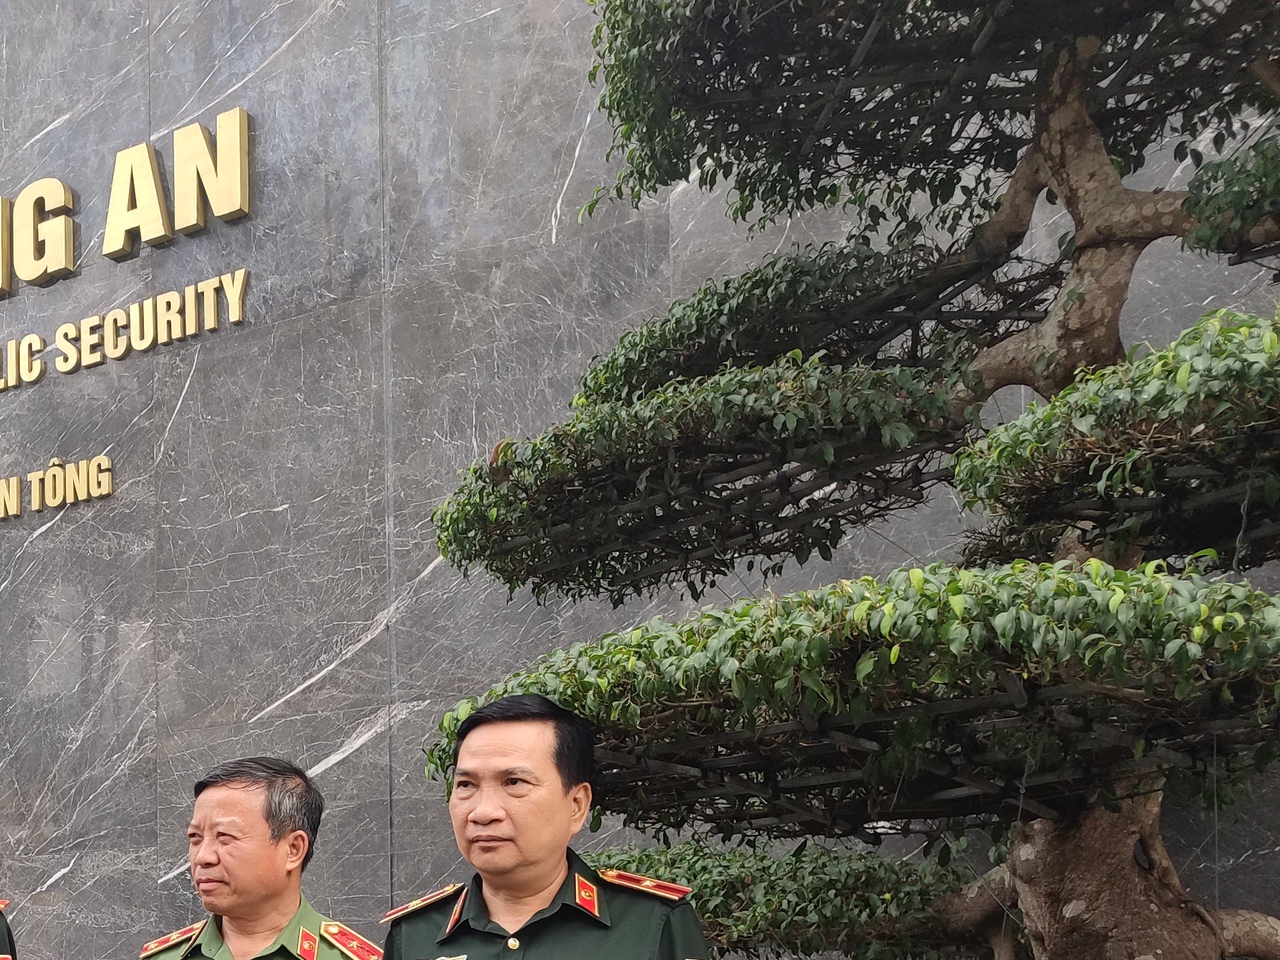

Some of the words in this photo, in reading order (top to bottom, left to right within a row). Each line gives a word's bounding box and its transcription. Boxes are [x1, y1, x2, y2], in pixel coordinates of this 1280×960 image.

[101, 106, 249, 263] AN
[54, 268, 249, 374] SECURITY
[27, 456, 113, 513] TÔNG
